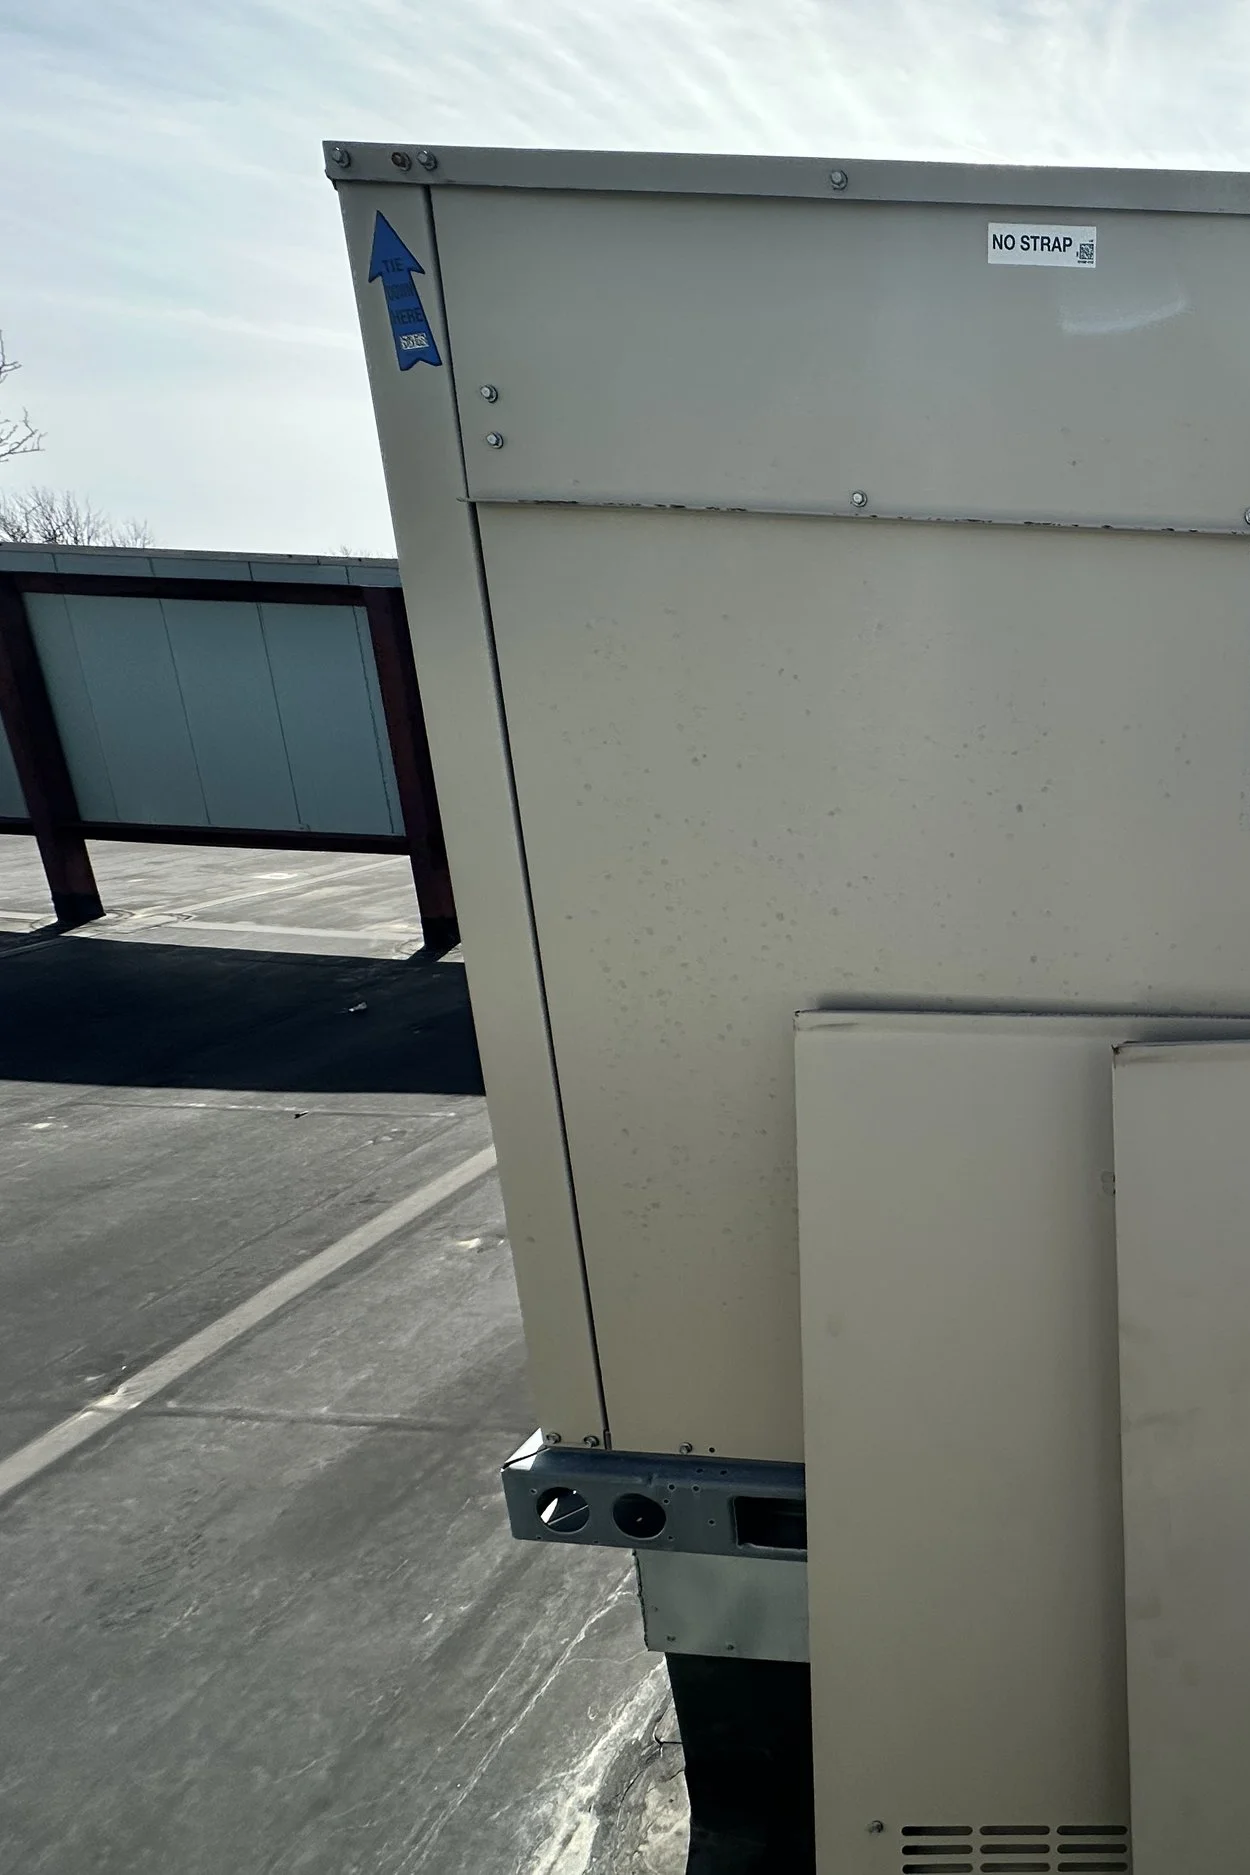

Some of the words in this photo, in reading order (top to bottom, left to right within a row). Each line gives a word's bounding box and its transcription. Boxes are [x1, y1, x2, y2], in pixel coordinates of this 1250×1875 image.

[993, 234, 1015, 250] NO
[1021, 235, 1072, 252] STRAP
[382, 257, 404, 272] TIE
[392, 308, 424, 324] HERE
